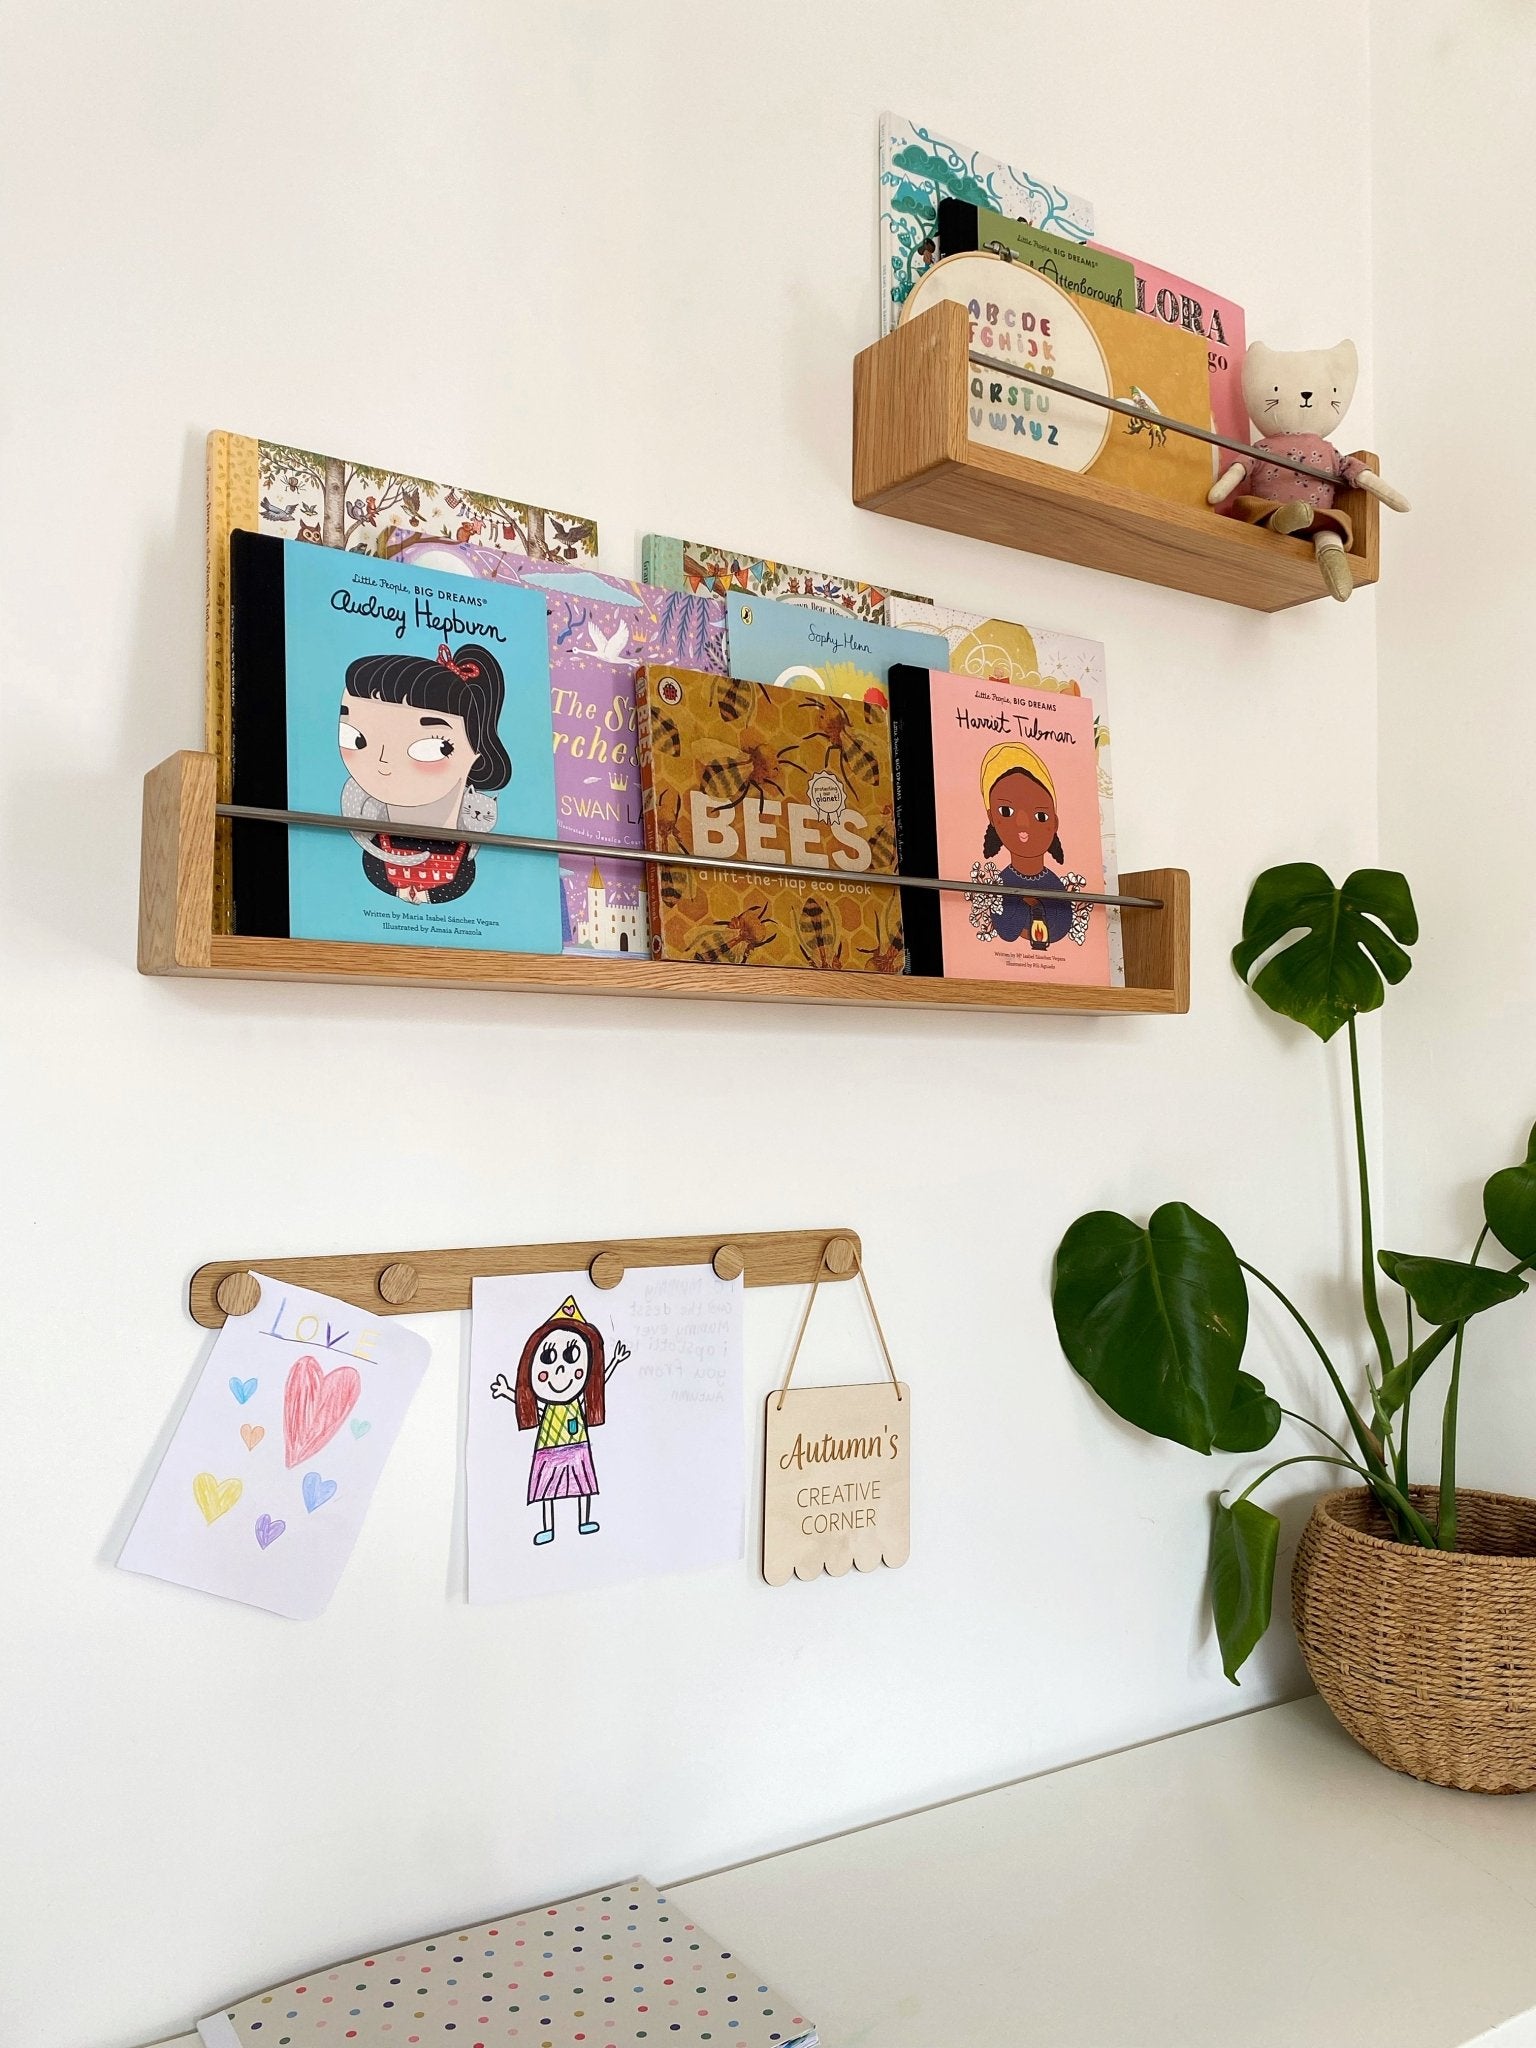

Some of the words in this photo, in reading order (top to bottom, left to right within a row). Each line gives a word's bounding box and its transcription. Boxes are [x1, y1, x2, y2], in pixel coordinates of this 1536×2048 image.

[1053, 246, 1066, 258] BIG
[352, 573, 378, 587] Little
[414, 585, 434, 597] BIG
[330, 589, 406, 639] Audrey
[415, 597, 507, 644] Hepburn
[807, 623, 843, 654] Sophy
[843, 632, 872, 654] Henn
[551, 687, 597, 720] The
[1013, 697, 1026, 706] BIG
[1028, 699, 1057, 712] DREAMS
[955, 707, 1012, 733] Harriet
[1012, 714, 1077, 745] Tubman
[560, 794, 621, 822] SWAN
[690, 790, 872, 872] BEES
[699, 870, 708, 881] a
[811, 880, 834, 892] eco
[838, 879, 872, 896] book
[363, 909, 391, 919] Written
[391, 911, 401, 920] by
[425, 913, 447, 923] Isabel
[382, 922, 419, 932] Illustrated
[420, 923, 429, 934] by
[271, 1297, 383, 1359] LOVE
[779, 1424, 899, 1471] Autumn's
[796, 1480, 881, 1508] CREATIVE
[801, 1508, 876, 1535] CORNER
